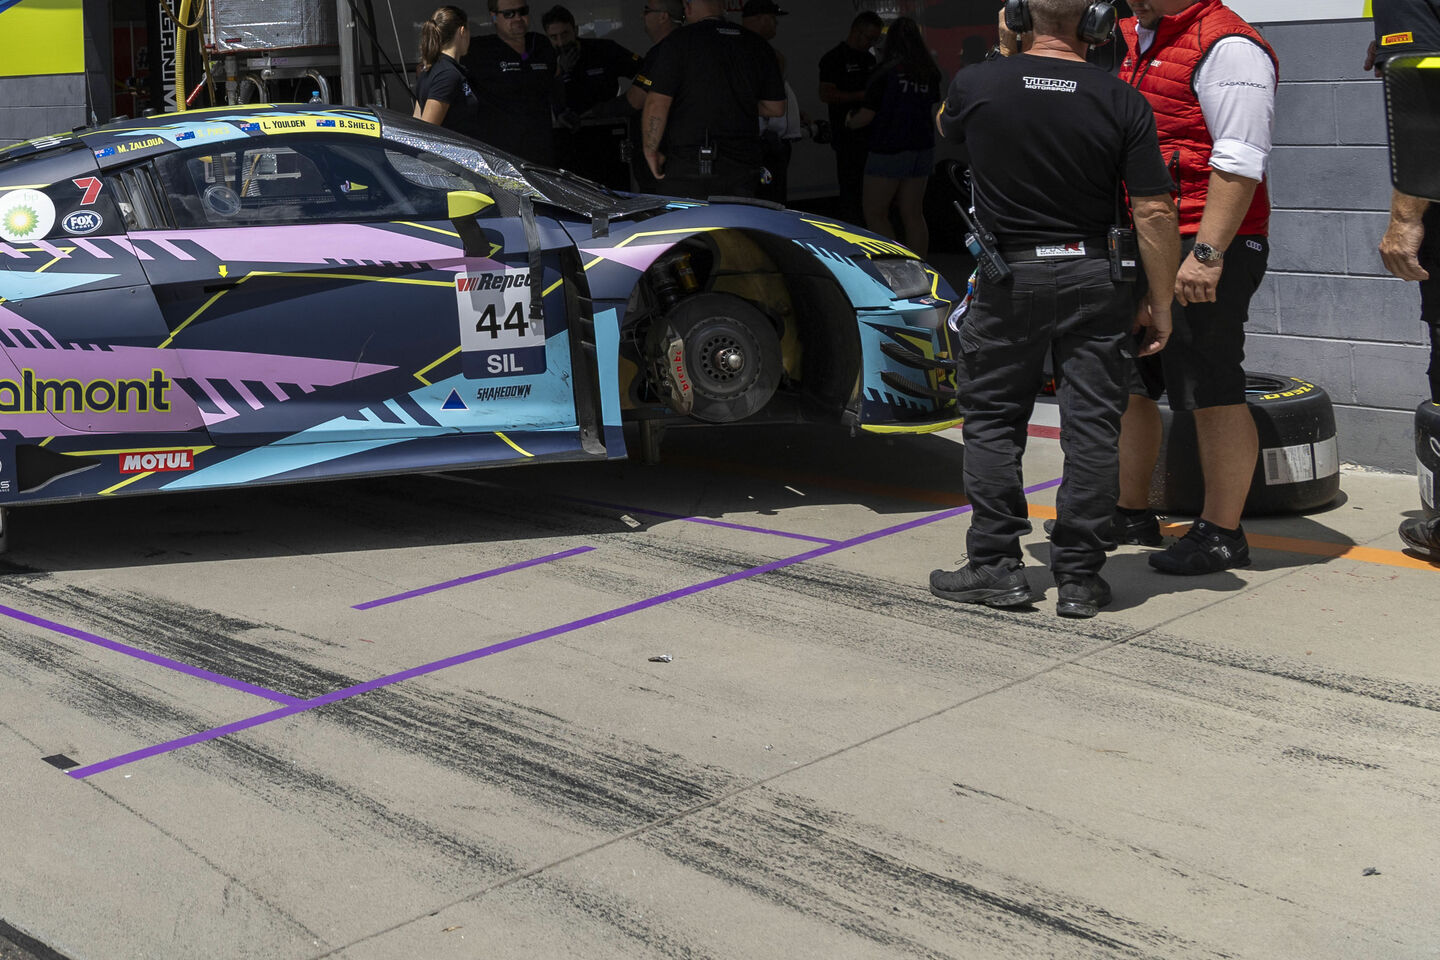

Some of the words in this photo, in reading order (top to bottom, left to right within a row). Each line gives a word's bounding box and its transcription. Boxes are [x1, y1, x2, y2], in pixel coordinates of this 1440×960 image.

[1023, 76, 1077, 88] TIGANI
[1025, 84, 1076, 93] MOTORSPORT
[263, 121, 271, 129] L.
[272, 120, 306, 129] YOULDEN
[339, 120, 347, 128] B.
[347, 120, 376, 131] SHIELS
[117, 144, 128, 154] M.
[130, 137, 164, 151] ZALLOUA
[72, 176, 103, 205] 7
[70, 215, 94, 227] FOX
[475, 301, 529, 339] 44
[487, 353, 524, 374] SIL
[123, 452, 191, 471] MOTUL
